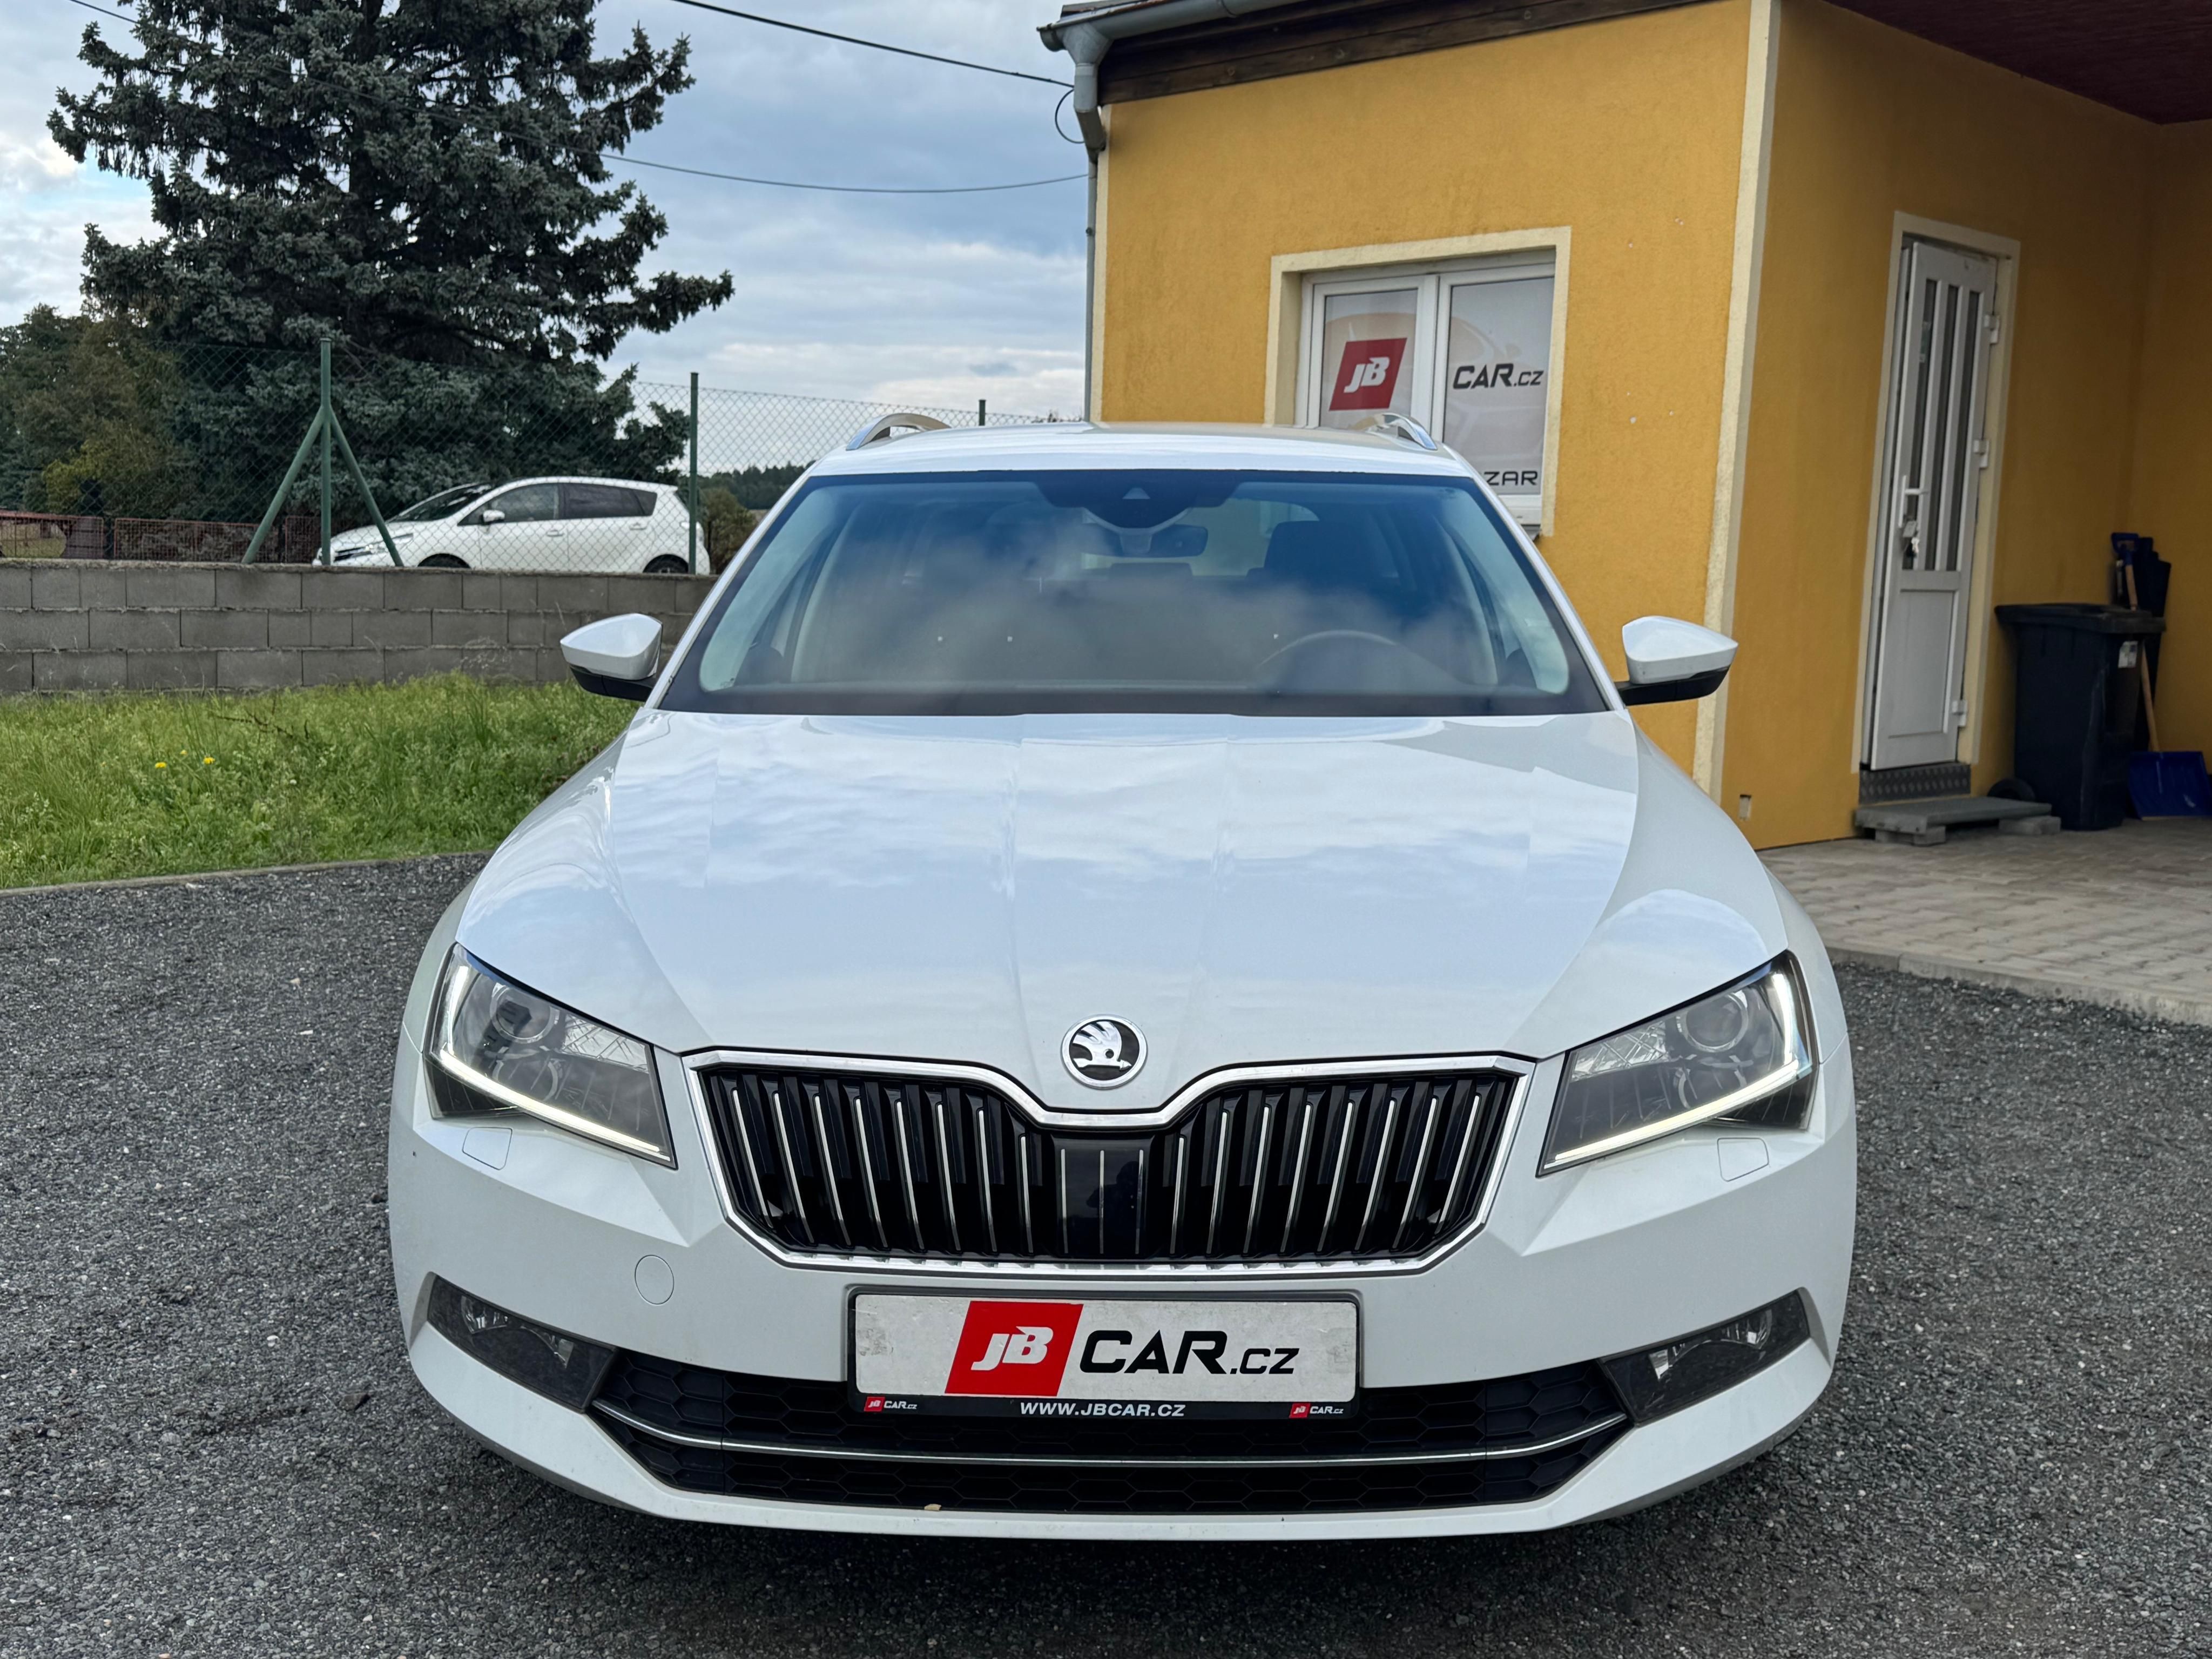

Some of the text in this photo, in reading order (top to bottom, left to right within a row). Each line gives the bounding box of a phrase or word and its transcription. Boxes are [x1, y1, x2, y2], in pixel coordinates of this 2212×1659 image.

[1344, 357, 1390, 393] JB
[1484, 471, 1537, 485] ZAR
[971, 1326, 1053, 1371] JB
[1021, 1402, 1186, 1417] WWW.JBCAR.CZ
